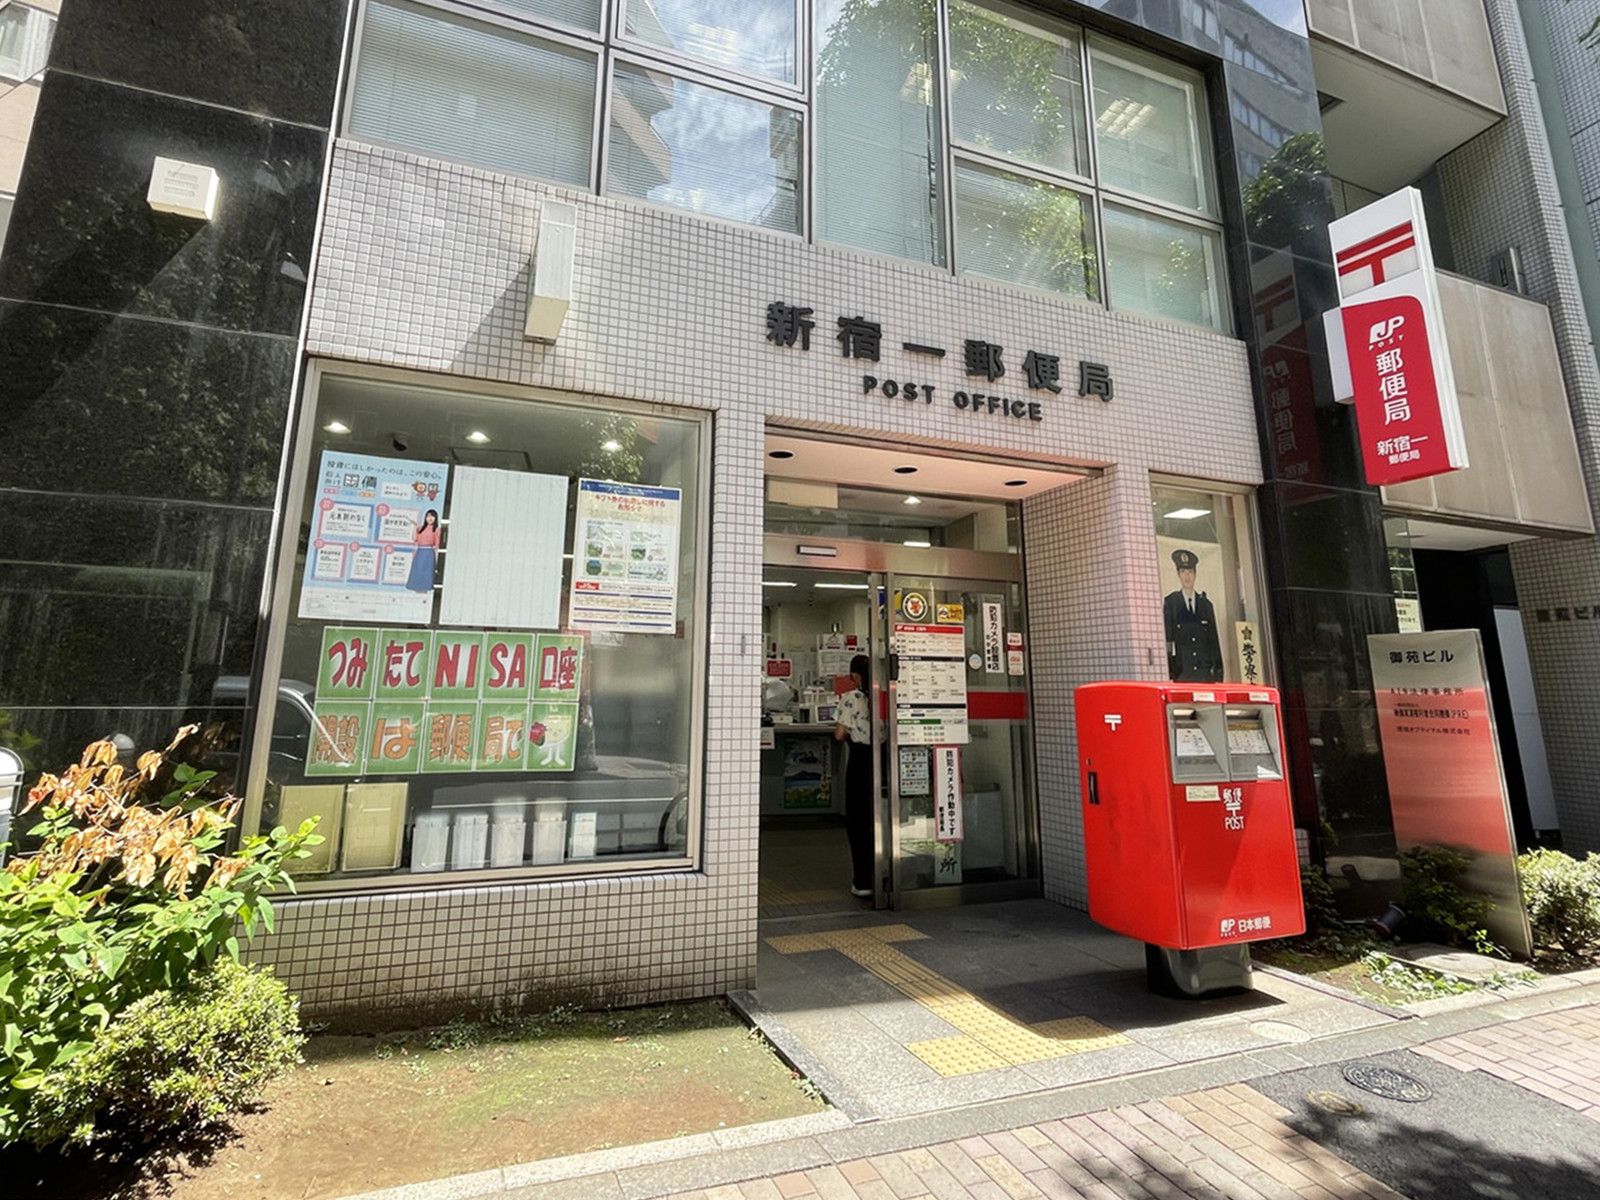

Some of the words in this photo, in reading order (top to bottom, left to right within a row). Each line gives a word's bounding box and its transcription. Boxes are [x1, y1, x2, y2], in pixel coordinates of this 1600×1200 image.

[1369, 315, 1405, 343] JP
[766, 300, 1114, 402] 新宿一郵便局
[1368, 334, 1404, 351] POST
[1376, 348, 1412, 426] 郵便局
[863, 375, 936, 405] POST
[953, 391, 1043, 422] OFFICE
[1377, 435, 1429, 456] 新宿一
[1388, 449, 1421, 466] 郵便局
[328, 637, 578, 690] つみたてNISA口座
[1241, 642, 1259, 685] 警察
[1389, 649, 1455, 664] 御苑ビル
[1223, 787, 1243, 804] 郵便
[1224, 815, 1245, 830] POST
[939, 857, 958, 876] 所
[1238, 915, 1272, 933] 日本郵便
